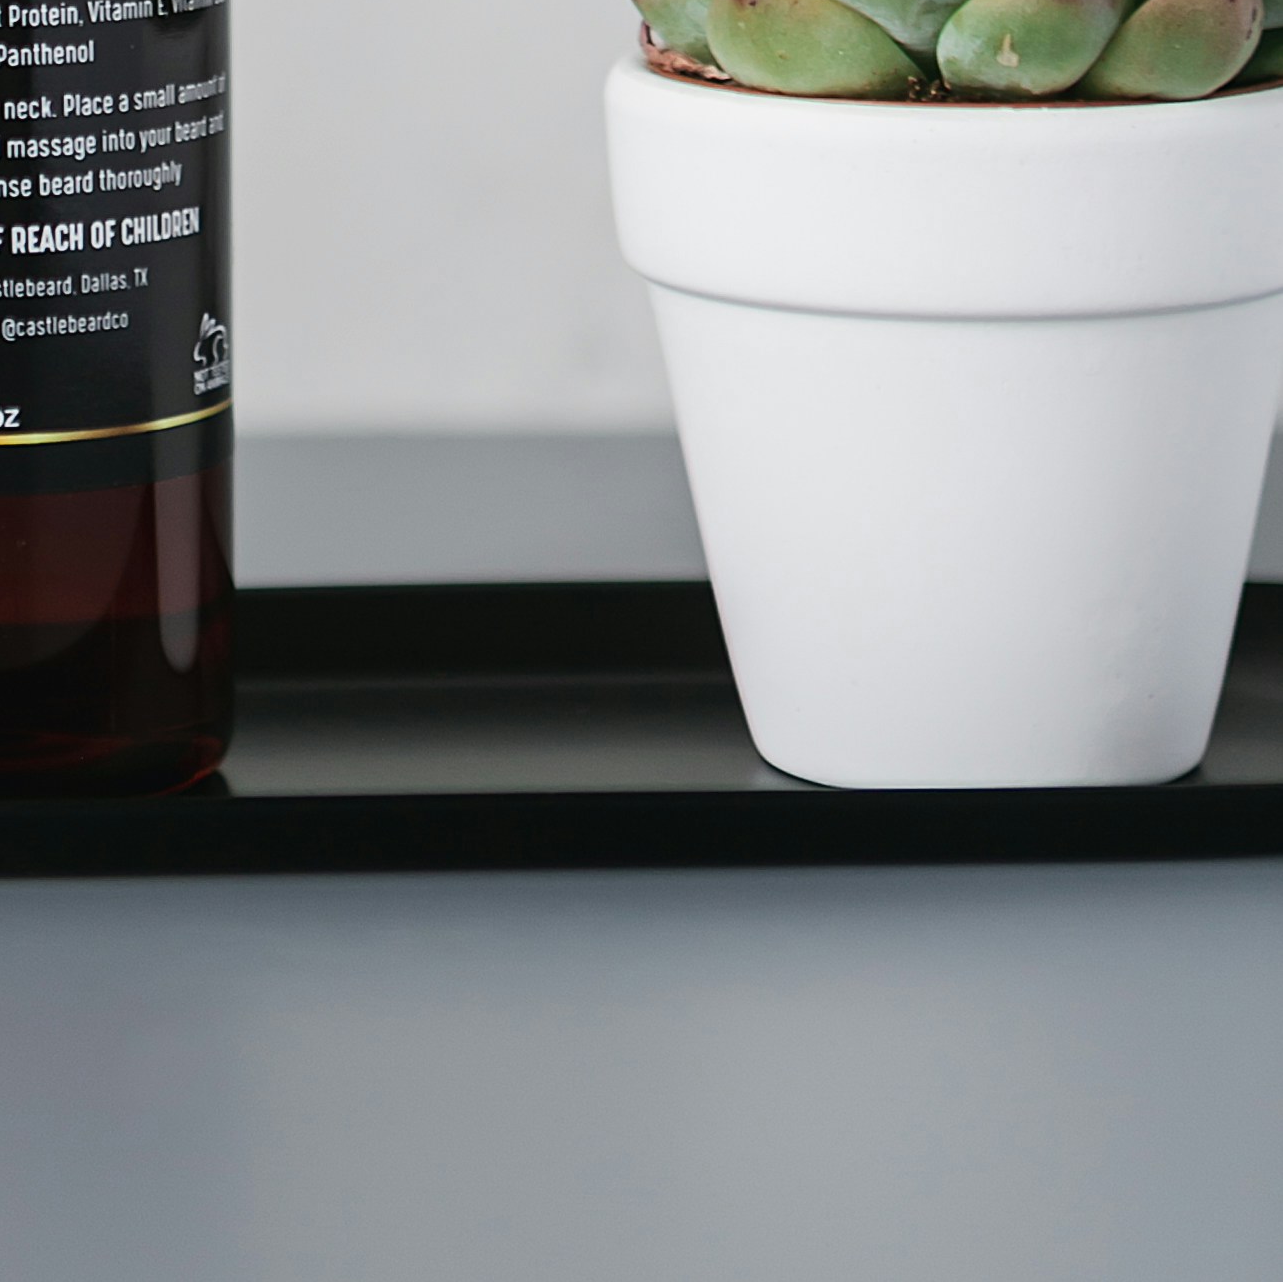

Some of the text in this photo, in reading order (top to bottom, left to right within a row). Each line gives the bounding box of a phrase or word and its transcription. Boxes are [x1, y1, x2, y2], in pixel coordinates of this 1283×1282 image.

[9, 2, 84, 27] Protein,
[4, 97, 57, 120] neck.
[63, 94, 113, 117] Place
[119, 93, 129, 112] a
[134, 84, 175, 111] small
[7, 135, 96, 160] massage
[102, 128, 135, 152] into
[139, 127, 171, 153] your
[175, 117, 207, 143] beard
[39, 171, 94, 197] beard
[99, 160, 182, 191] thoroughly
[11, 223, 84, 254] REACH
[91, 219, 117, 249] OF
[121, 207, 200, 246] CHILDREN
[134, 267, 149, 287] TX
[1, 312, 129, 341] @castlebeardco
